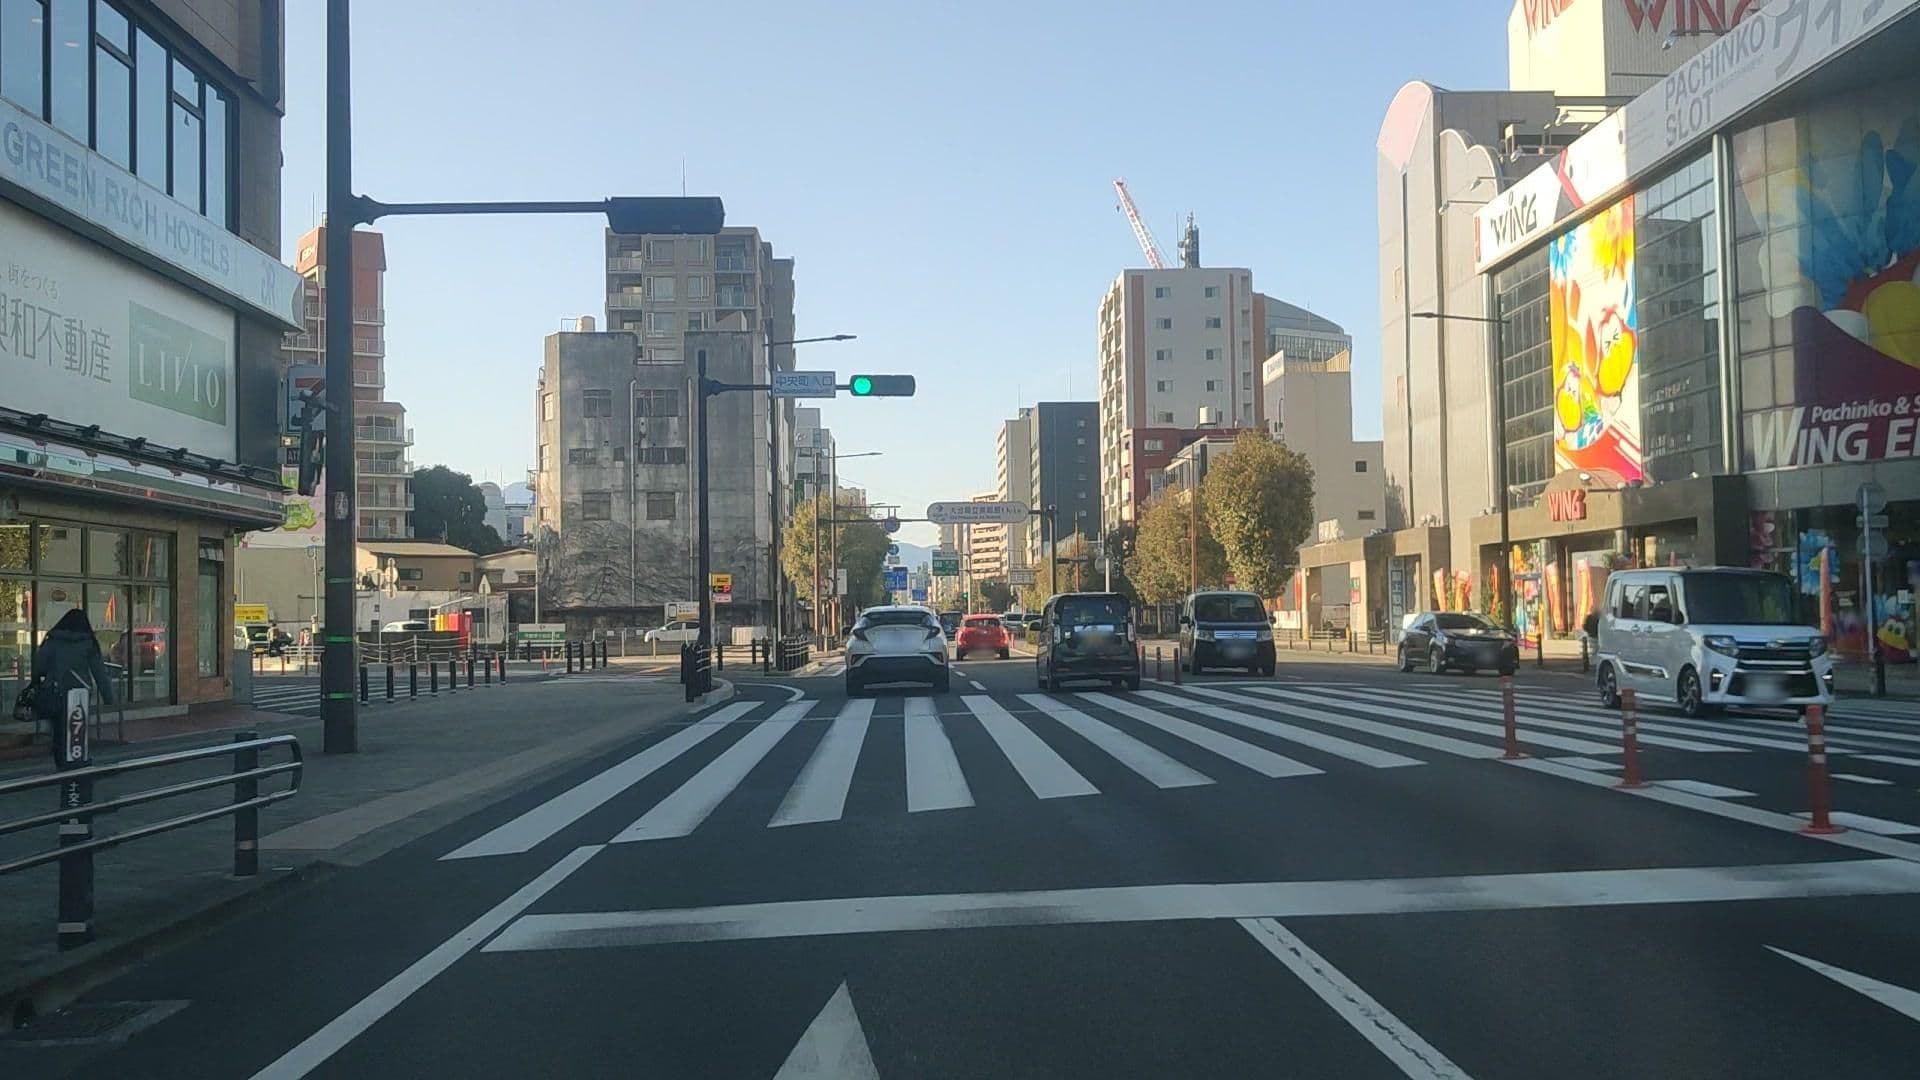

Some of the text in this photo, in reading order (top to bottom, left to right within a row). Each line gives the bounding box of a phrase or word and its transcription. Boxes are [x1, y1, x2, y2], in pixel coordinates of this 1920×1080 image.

[1665, 15, 1766, 112] PACHINKO
[1665, 88, 1713, 147] SLOT
[3, 121, 230, 275] GREEN RICH HOTELS
[138, 343, 220, 409] LIVIO
[1752, 406, 1869, 473] WING
[1811, 400, 1891, 425] Pachinko
[1894, 396, 1911, 416] &
[1548, 489, 1586, 521] WING
